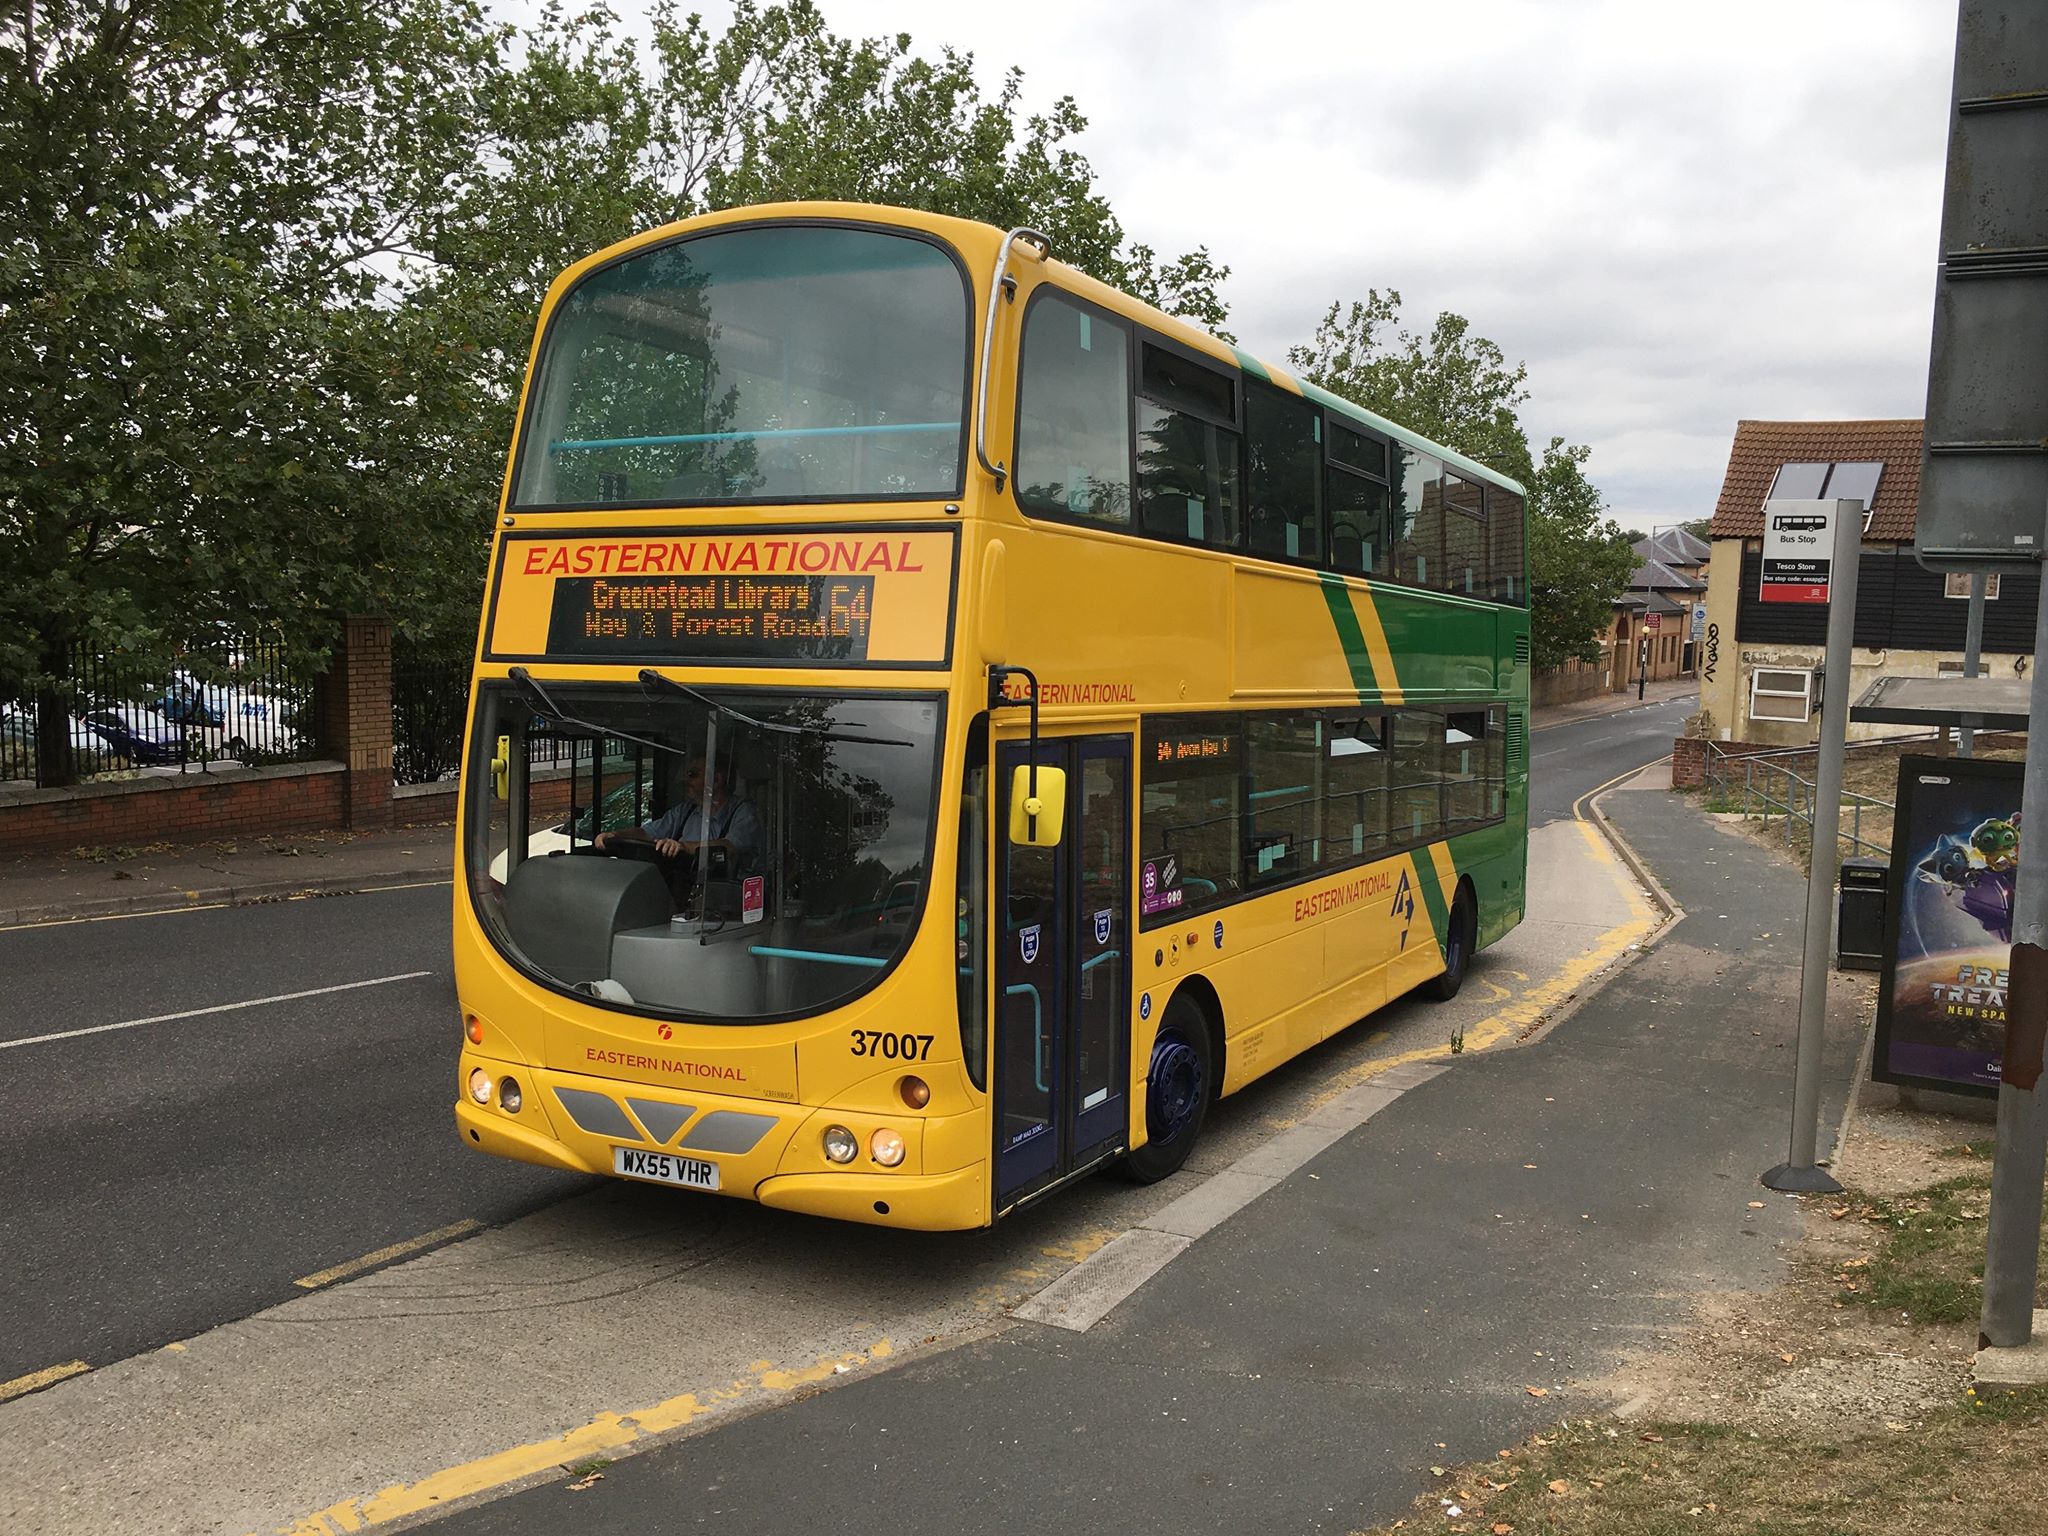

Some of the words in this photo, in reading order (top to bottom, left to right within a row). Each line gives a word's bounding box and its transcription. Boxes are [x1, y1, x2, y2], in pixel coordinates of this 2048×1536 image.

[1798, 535, 1816, 544] Stop
[523, 542, 695, 574] EASTERN
[702, 541, 924, 573] NATIONAL
[593, 580, 716, 609] Greenstead
[724, 580, 809, 609] Library
[585, 611, 628, 637] Way
[642, 611, 656, 637] &
[672, 612, 754, 638] Forest
[831, 585, 870, 637] 64
[1003, 684, 1071, 703] EASERN
[1072, 684, 1136, 703] NATIONAL
[1145, 872, 1154, 888] 35
[1295, 886, 1345, 922] EASTERN
[1345, 871, 1391, 905] NATIONAL
[1930, 983, 2008, 1007] TREA
[1948, 1005, 1974, 1017] NEW
[850, 1028, 935, 1061] 37007
[586, 1048, 658, 1070] EASTERN
[661, 1060, 746, 1081] NATIONAL
[623, 1151, 670, 1177] WX55
[676, 1159, 712, 1185] VHR
